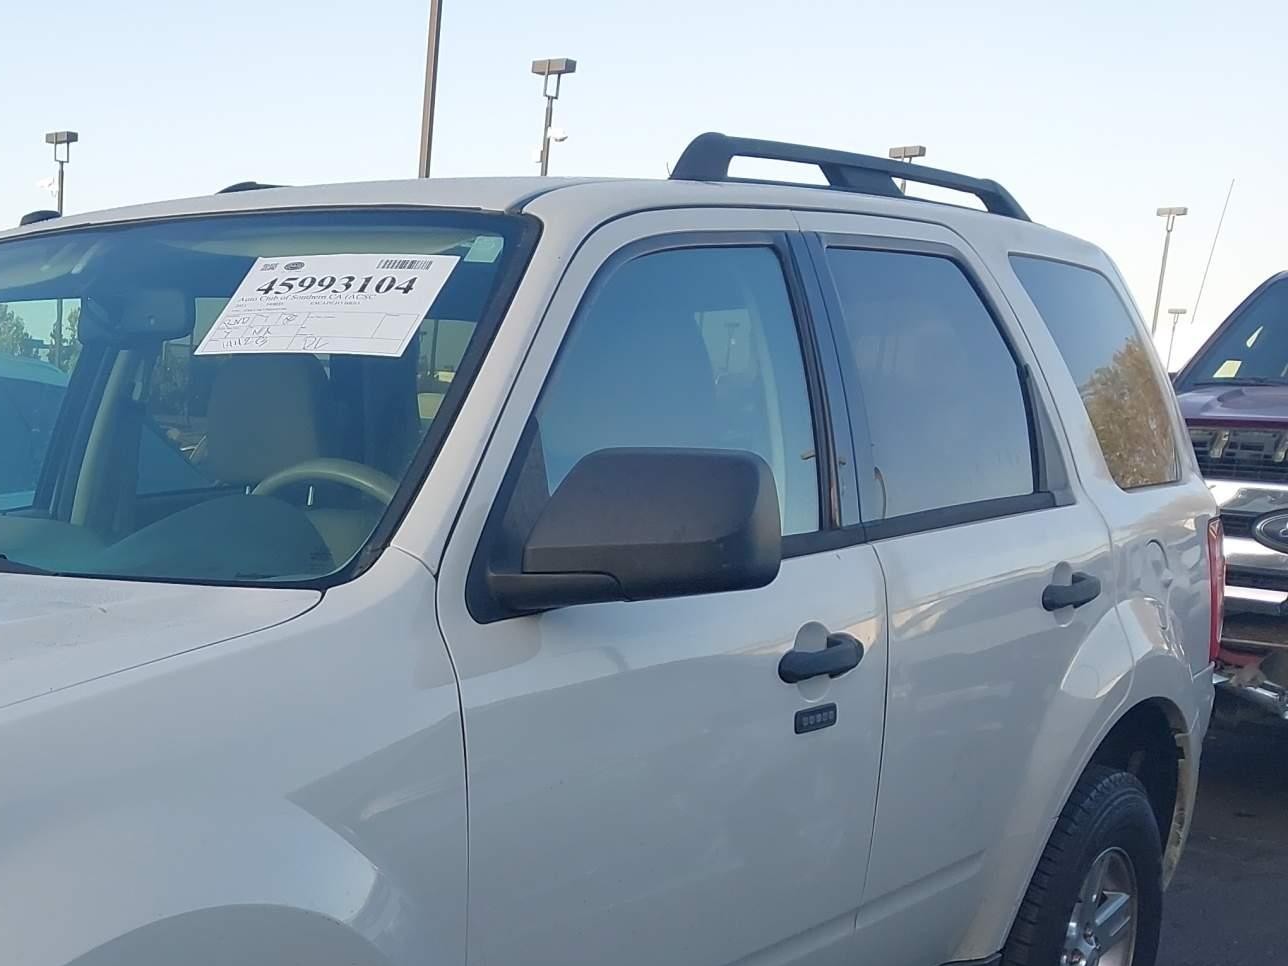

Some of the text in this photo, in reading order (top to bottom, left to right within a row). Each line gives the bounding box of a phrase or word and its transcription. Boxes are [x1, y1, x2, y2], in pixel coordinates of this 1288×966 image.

[256, 275, 418, 295] 45993104
[260, 294, 280, 302] Club
[291, 293, 327, 301] Southern
